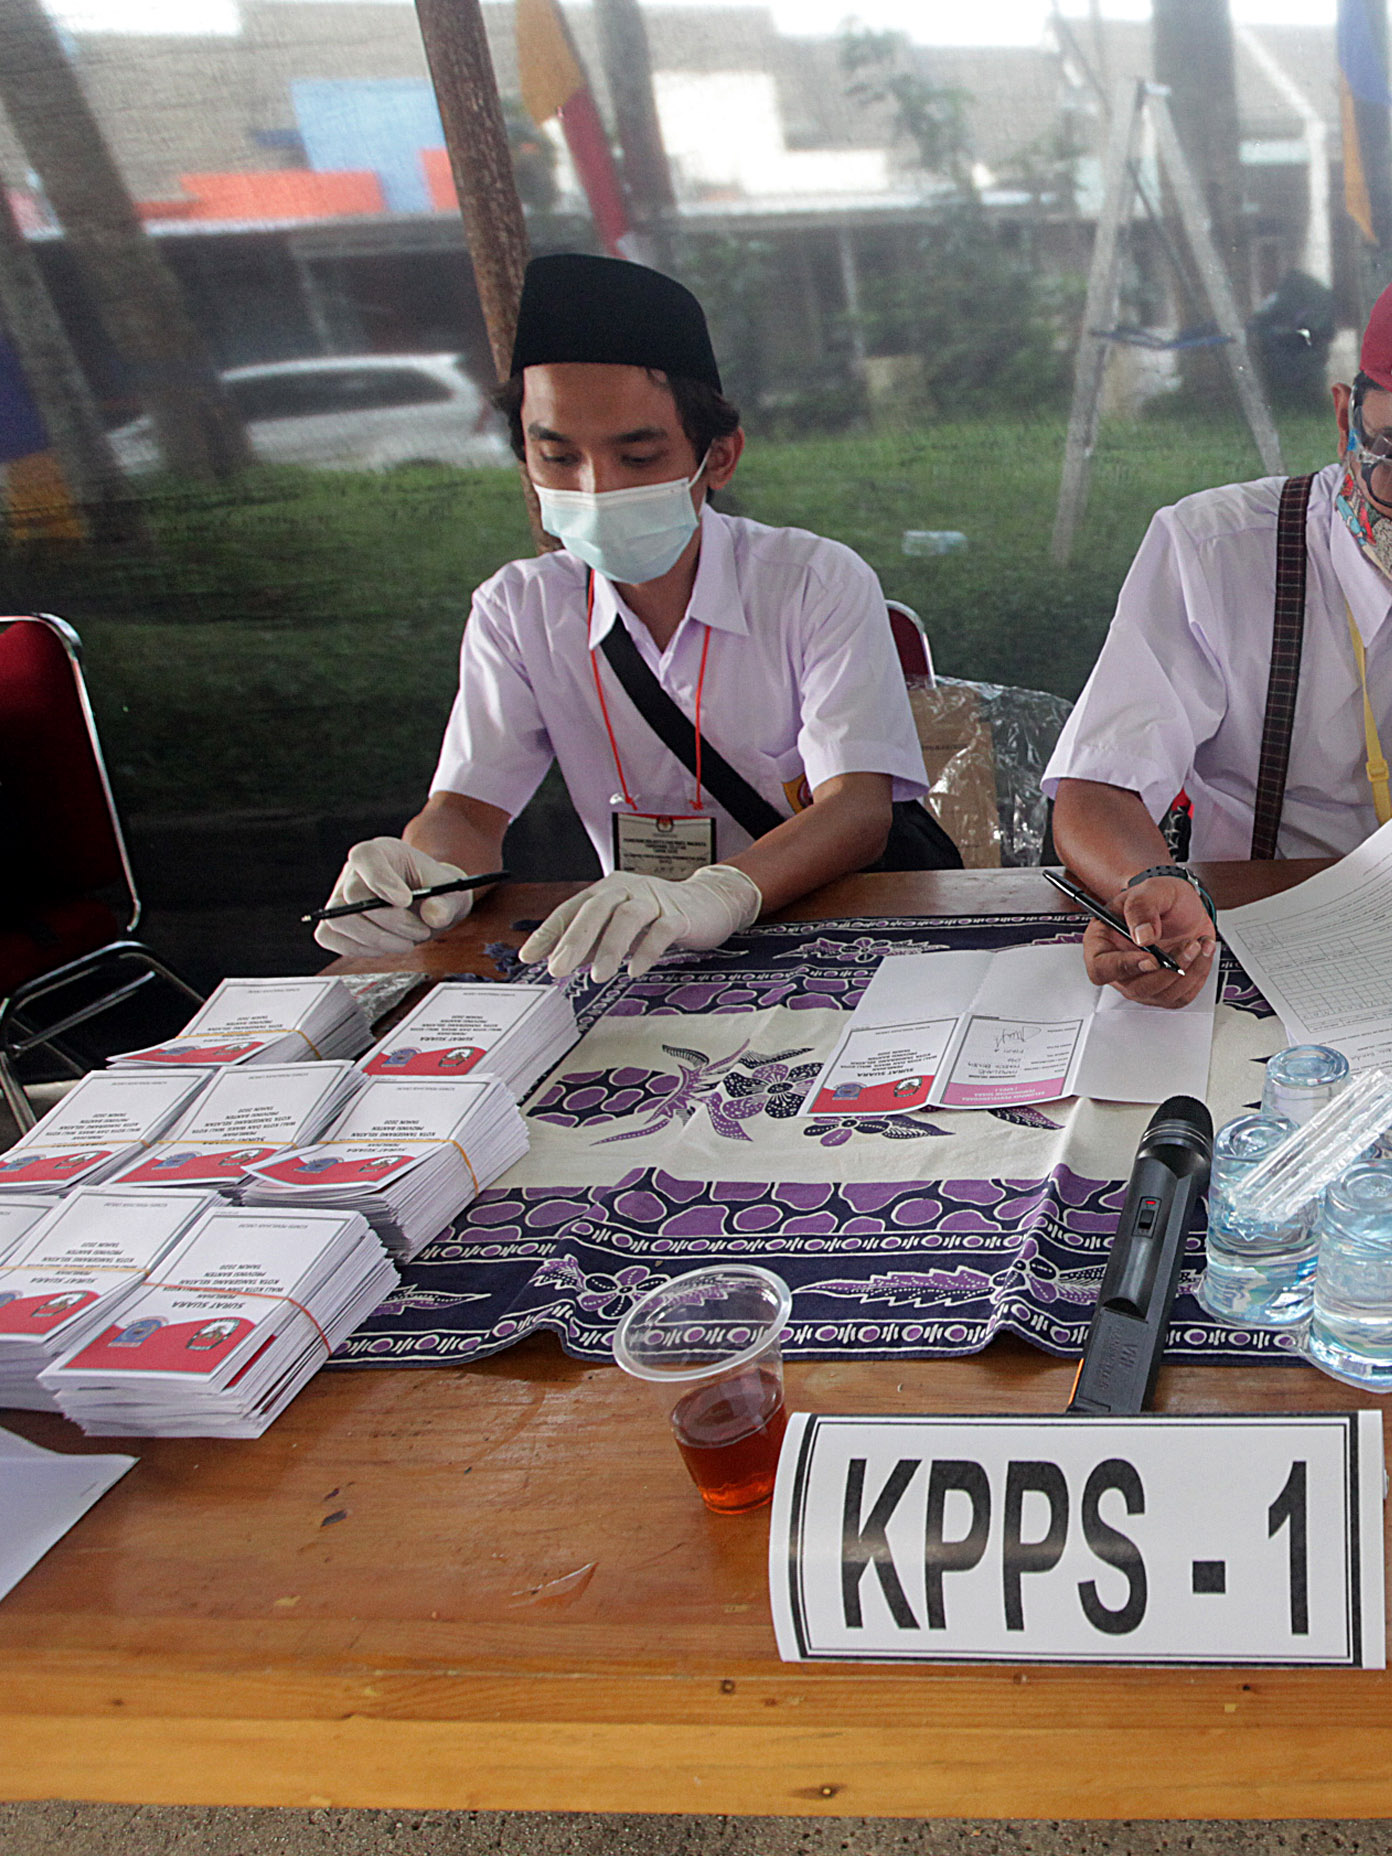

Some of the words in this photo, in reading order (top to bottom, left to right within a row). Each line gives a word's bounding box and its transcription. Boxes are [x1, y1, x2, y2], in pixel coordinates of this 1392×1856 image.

[171, 1301, 208, 1309] SUARA
[209, 1302, 245, 1310] SURAT
[841, 1458, 1148, 1636] KPPS
[1267, 1460, 1308, 1636] 1
